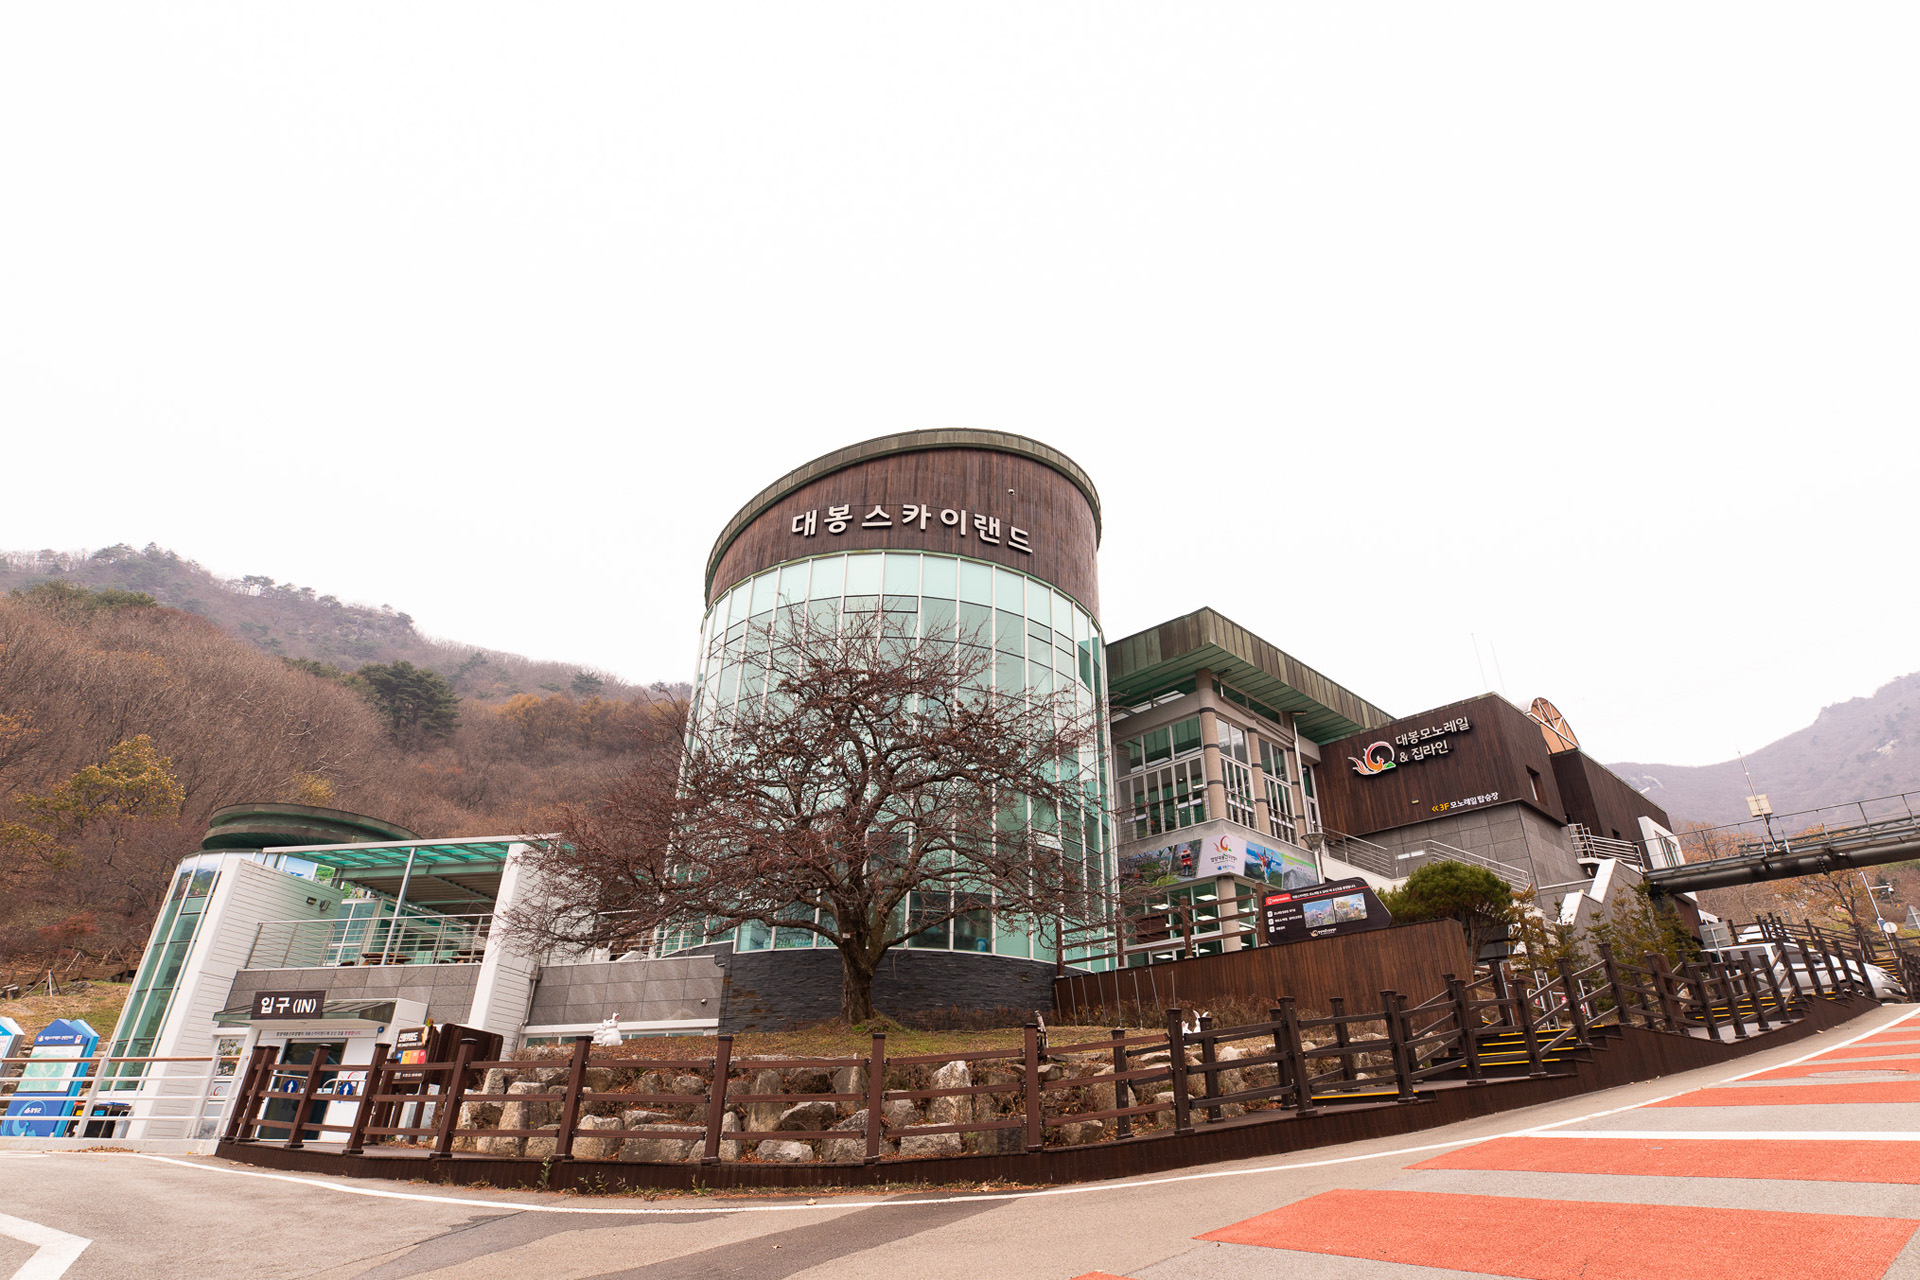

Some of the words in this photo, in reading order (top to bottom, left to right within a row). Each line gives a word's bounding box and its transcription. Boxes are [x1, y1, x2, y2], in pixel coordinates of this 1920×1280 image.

[792, 504, 1033, 554] 대봉스카이랜드
[1395, 716, 1471, 746] 대봉모노레일
[1399, 751, 1409, 763] &
[1411, 740, 1449, 761] 집라인
[1439, 802, 1450, 812] 3F
[1450, 797, 1478, 809] 모노레일
[260, 996, 291, 1014] 입구
[292, 998, 317, 1014] (IN)
